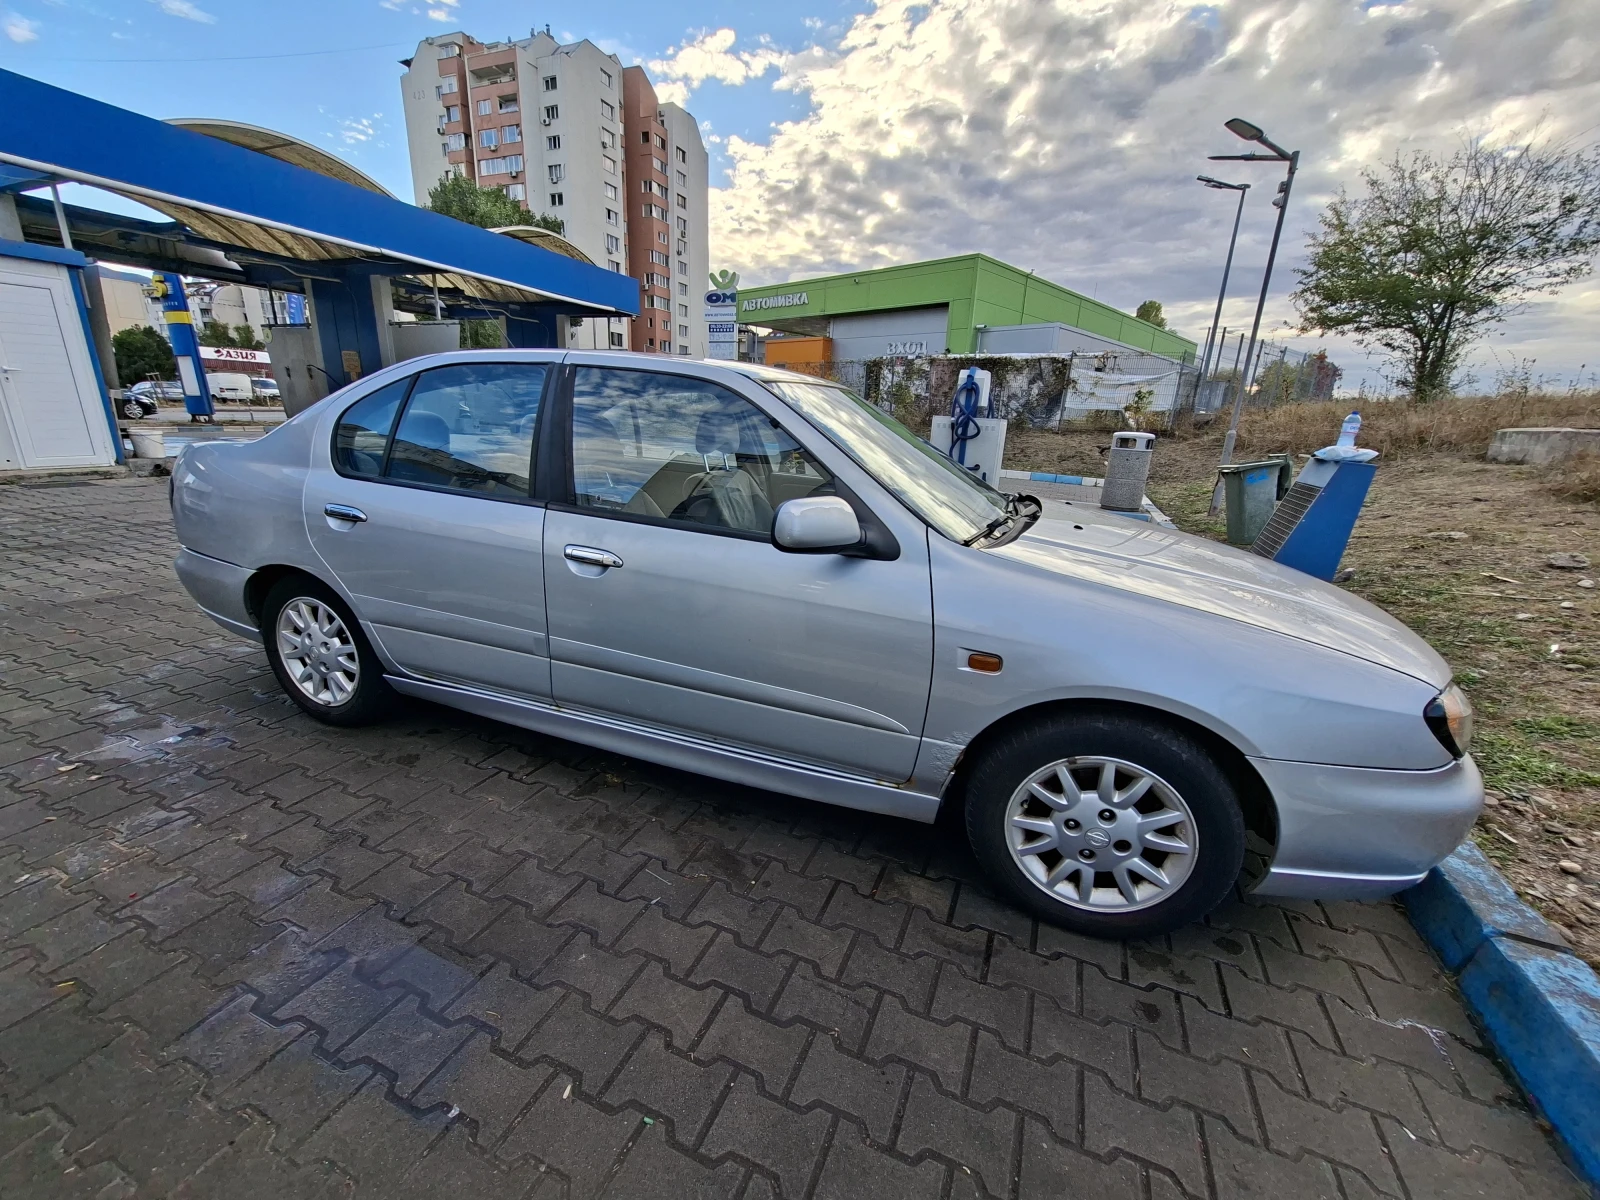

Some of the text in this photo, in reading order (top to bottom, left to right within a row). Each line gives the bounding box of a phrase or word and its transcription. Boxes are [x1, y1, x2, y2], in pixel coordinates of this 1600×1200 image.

[742, 292, 808, 312] АВТОМИВКА
[224, 350, 257, 360] АЗИЯ
[886, 340, 927, 356] ВХОД
